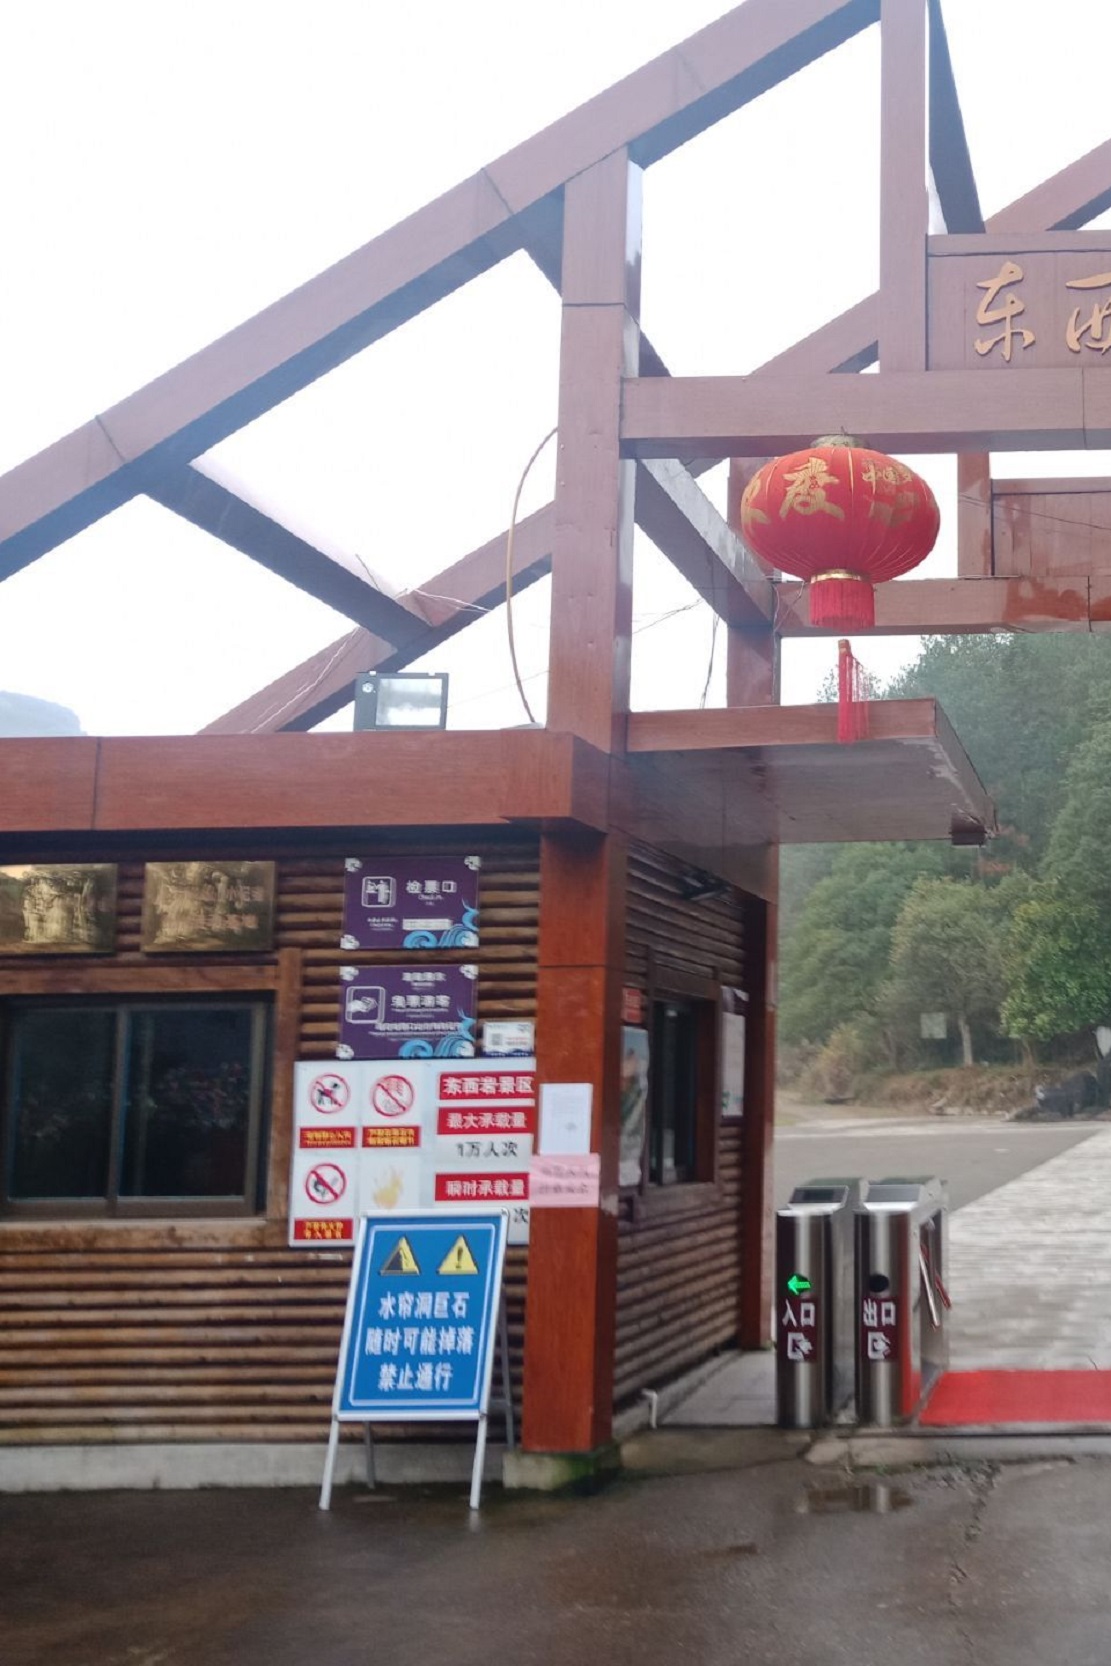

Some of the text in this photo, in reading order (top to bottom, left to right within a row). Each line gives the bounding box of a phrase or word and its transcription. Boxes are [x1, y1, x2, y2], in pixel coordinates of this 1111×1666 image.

[443, 1075, 534, 1096] 东西岩景区
[447, 1112, 527, 1129] 最大承载量
[456, 1141, 518, 1158] 1万人次
[445, 1179, 525, 1198] 瞬时承载量
[378, 1291, 470, 1320] 水帘洞巨石
[782, 1299, 815, 1327] 入口
[863, 1299, 896, 1327] 出口
[365, 1326, 475, 1356] 随时可能掉落
[378, 1361, 453, 1392] 禁止通行
